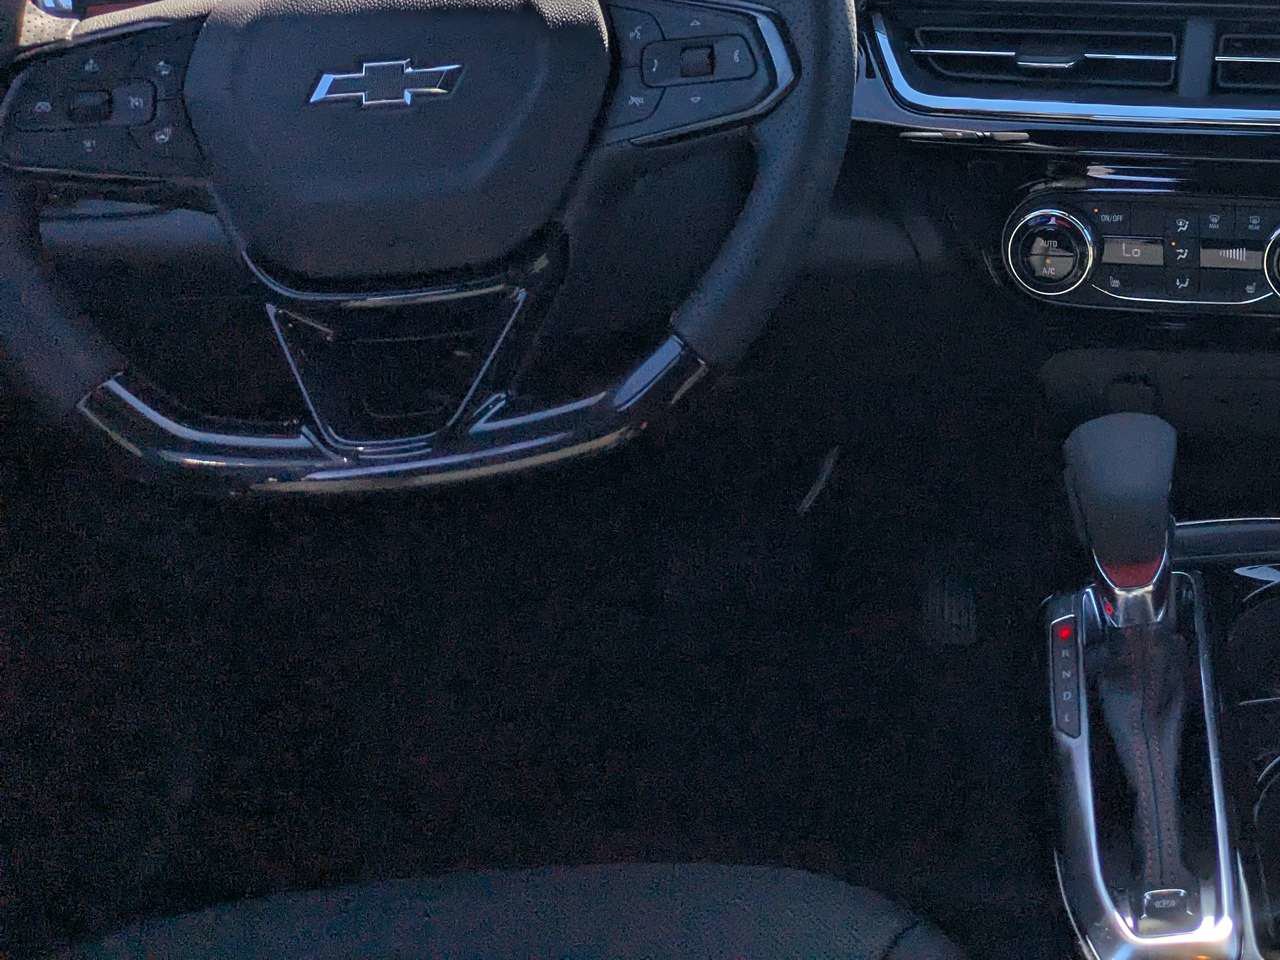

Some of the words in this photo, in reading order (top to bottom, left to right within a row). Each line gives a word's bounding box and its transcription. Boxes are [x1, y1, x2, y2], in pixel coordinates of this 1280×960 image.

[1100, 214, 1123, 222] ON/OFF
[1039, 240, 1058, 249] AUTO
[1122, 242, 1141, 257] Lo
[1042, 267, 1056, 275] A/C
